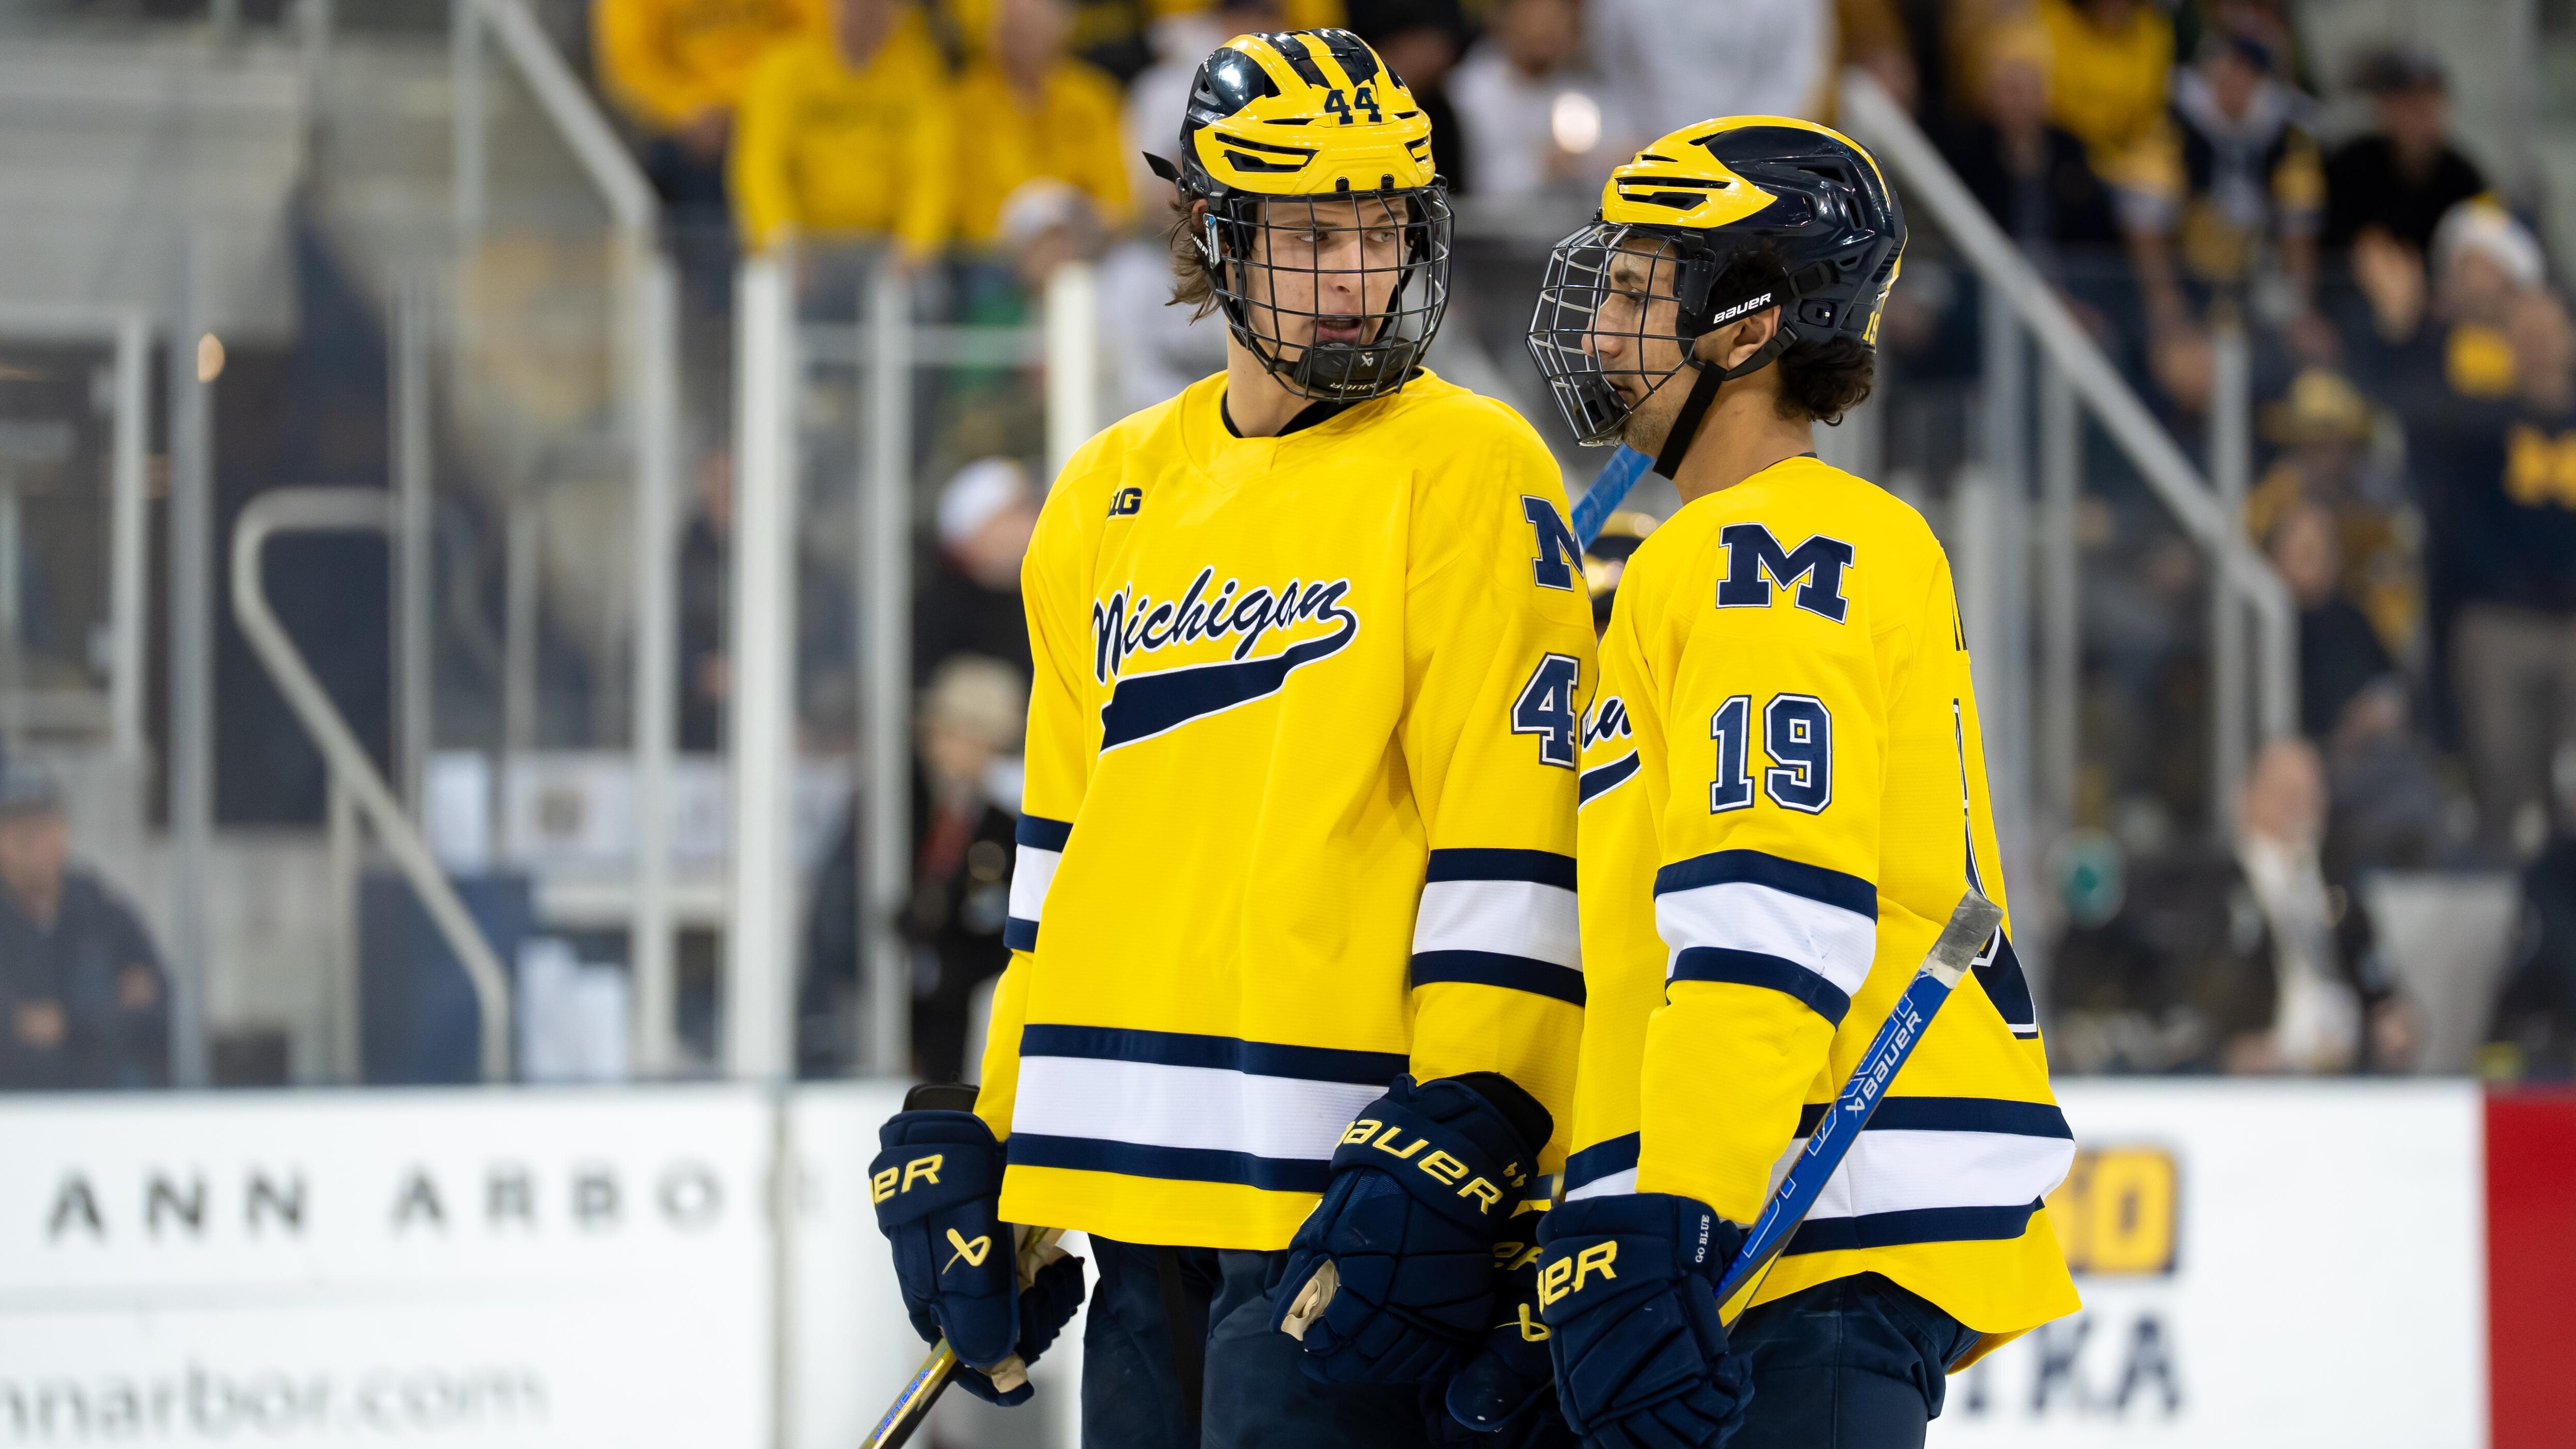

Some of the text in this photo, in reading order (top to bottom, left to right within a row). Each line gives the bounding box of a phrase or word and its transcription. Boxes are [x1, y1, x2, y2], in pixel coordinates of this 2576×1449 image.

[1324, 88, 1382, 125] 44
[1713, 292, 1771, 324] BAUER
[1862, 311, 1880, 345] 19
[1716, 521, 1855, 625] M
[1091, 564, 1359, 686] Michigan
[1710, 692, 1832, 815] 19
[1862, 1010, 1922, 1102] BAUER
[47, 1162, 824, 1239] ANN ARBO
[869, 1153, 944, 1210] ER
[1695, 1215, 1710, 1263] GO BLUE
[1537, 1240, 1618, 1315] ER
